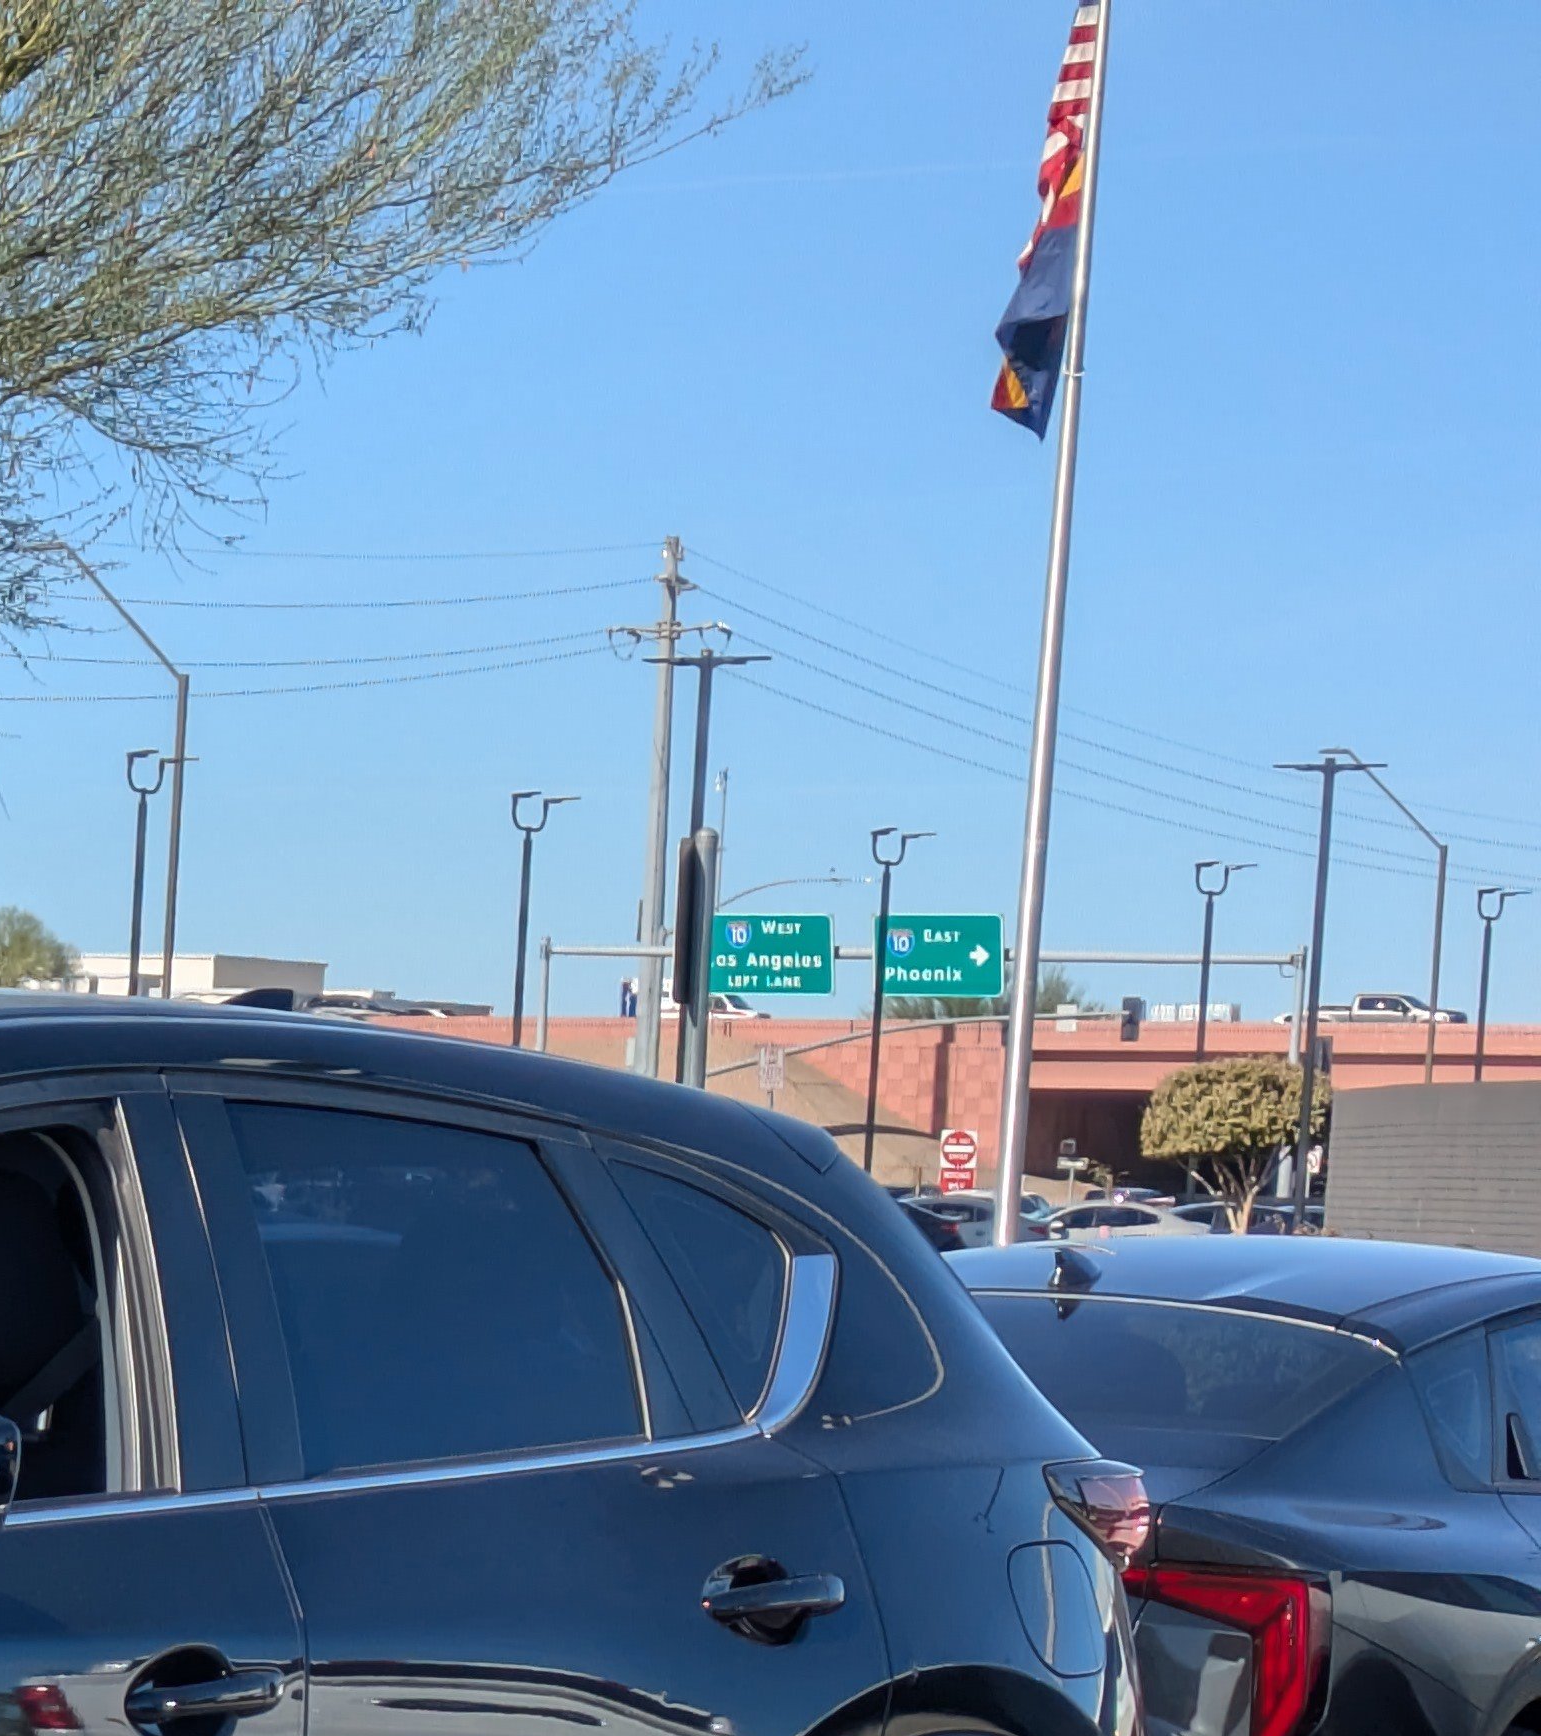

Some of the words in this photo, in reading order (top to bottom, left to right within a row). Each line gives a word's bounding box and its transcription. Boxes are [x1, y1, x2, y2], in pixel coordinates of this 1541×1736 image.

[731, 927, 747, 944] 10
[892, 937, 910, 952] 10
[746, 952, 822, 971] Angeles
[885, 967, 963, 982] Phoenix
